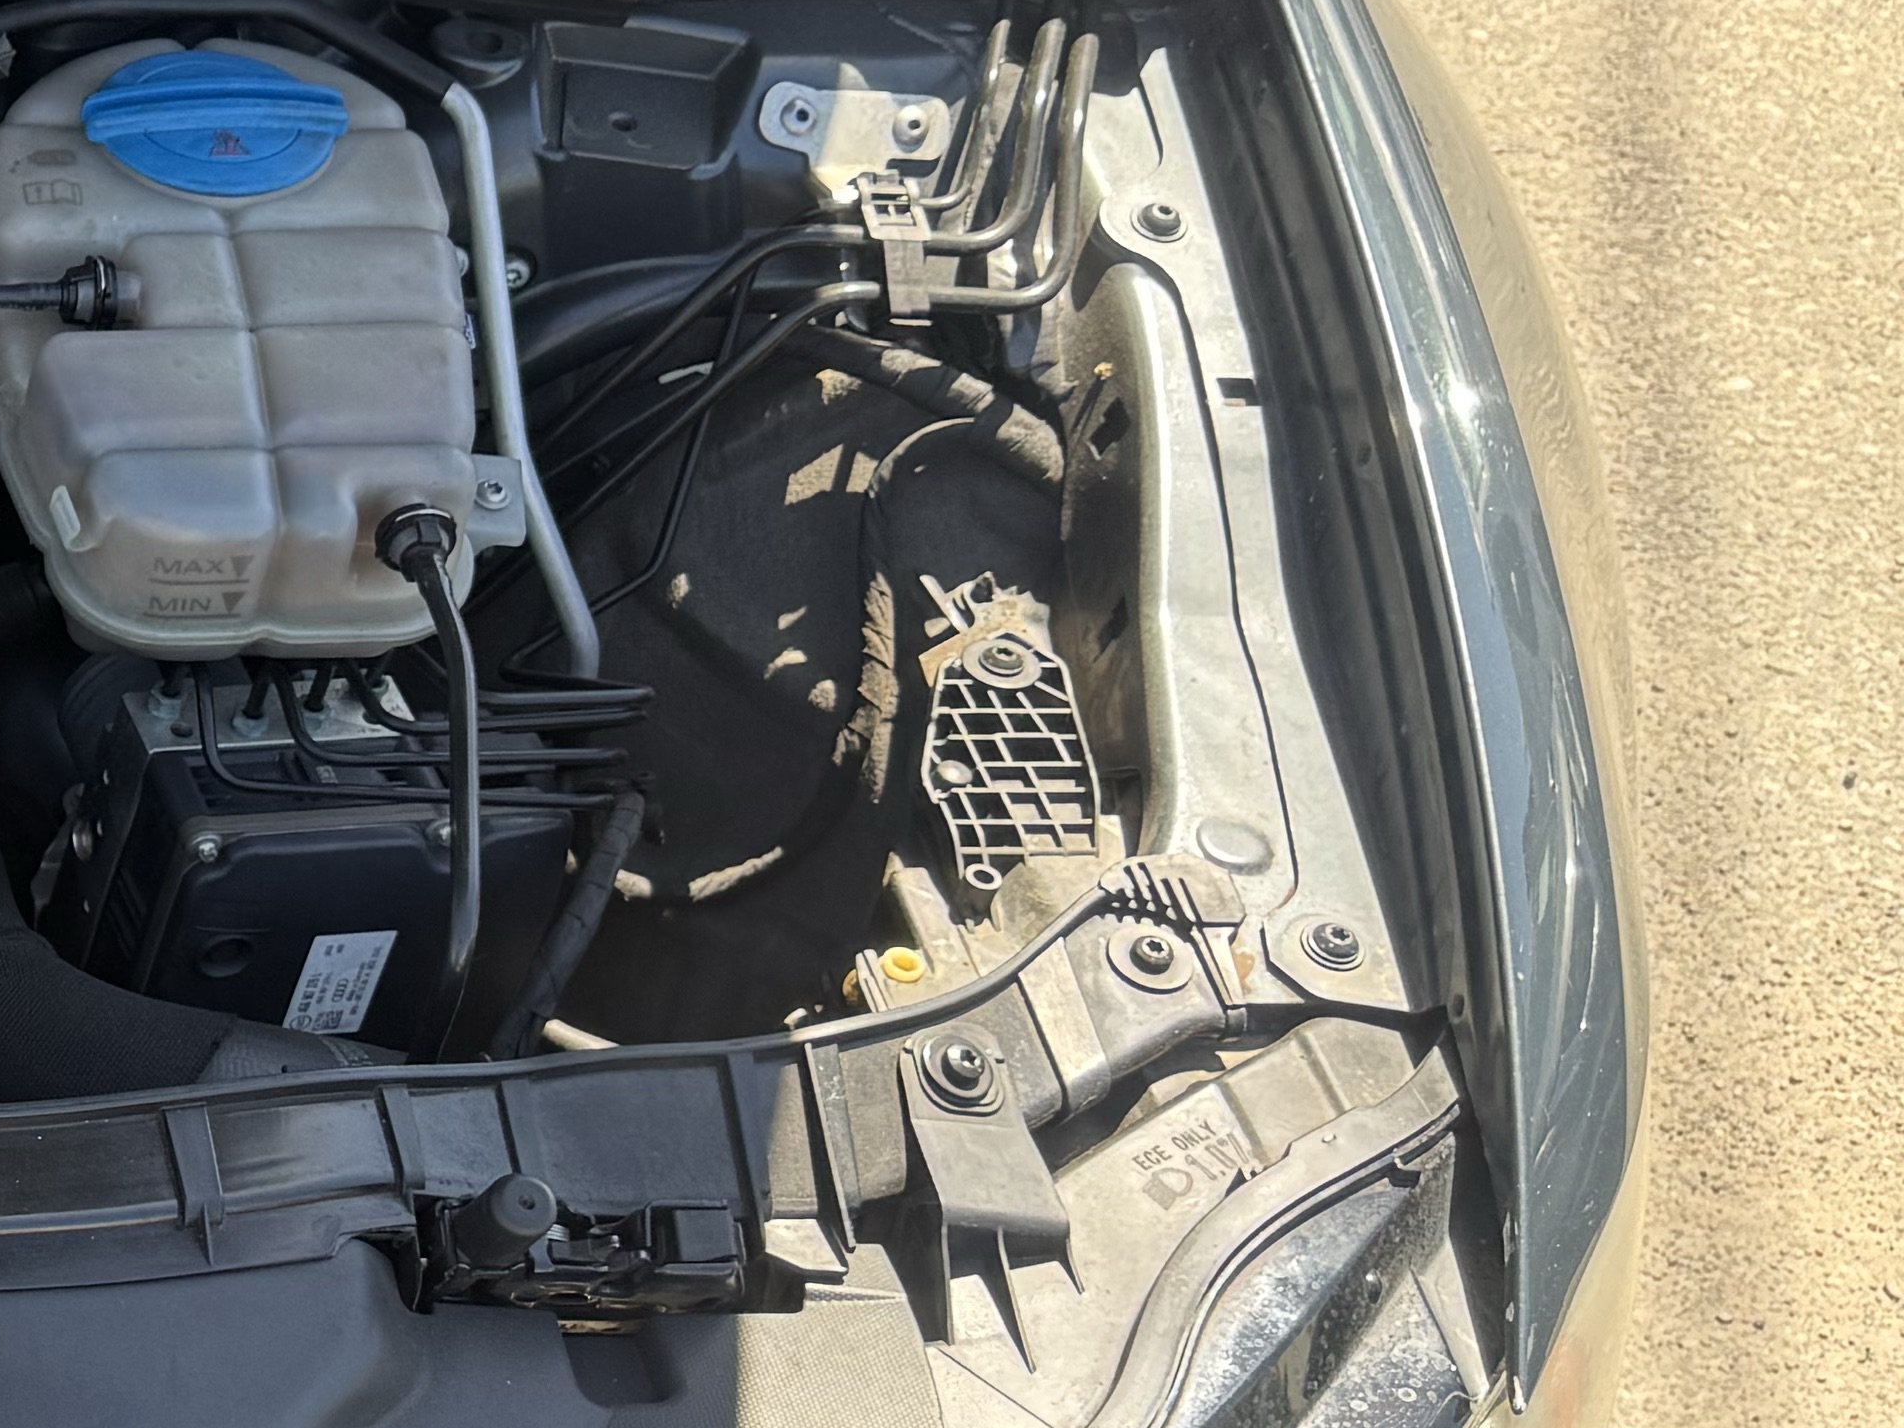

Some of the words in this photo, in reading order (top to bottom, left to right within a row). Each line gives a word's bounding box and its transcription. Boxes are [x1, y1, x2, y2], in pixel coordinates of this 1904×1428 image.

[152, 555, 227, 576] MAX
[149, 594, 212, 613] MIN
[1132, 1144, 1173, 1171] ECE
[1171, 1119, 1217, 1152] ONLY
